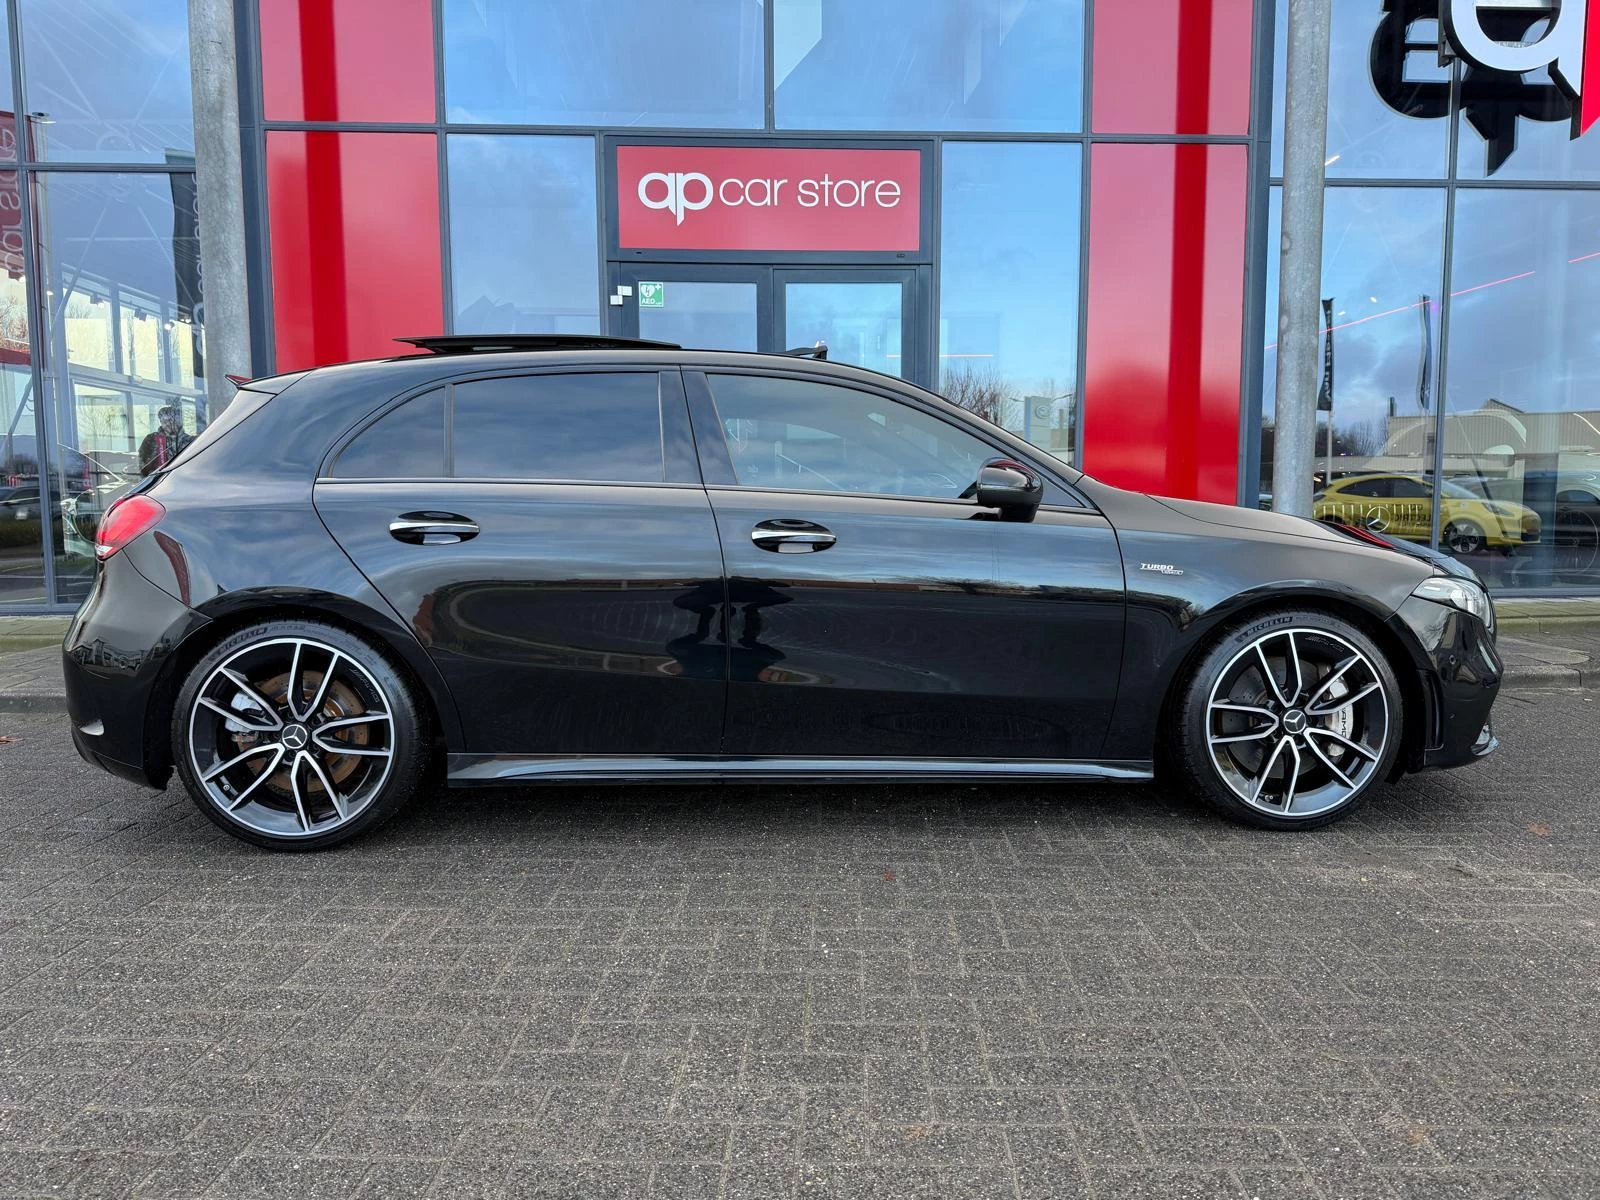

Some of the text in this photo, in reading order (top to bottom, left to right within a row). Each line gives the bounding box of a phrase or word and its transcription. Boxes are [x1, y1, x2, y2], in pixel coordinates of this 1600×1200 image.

[638, 172, 900, 226] ap car store
[1140, 563, 1174, 571] TURBO
